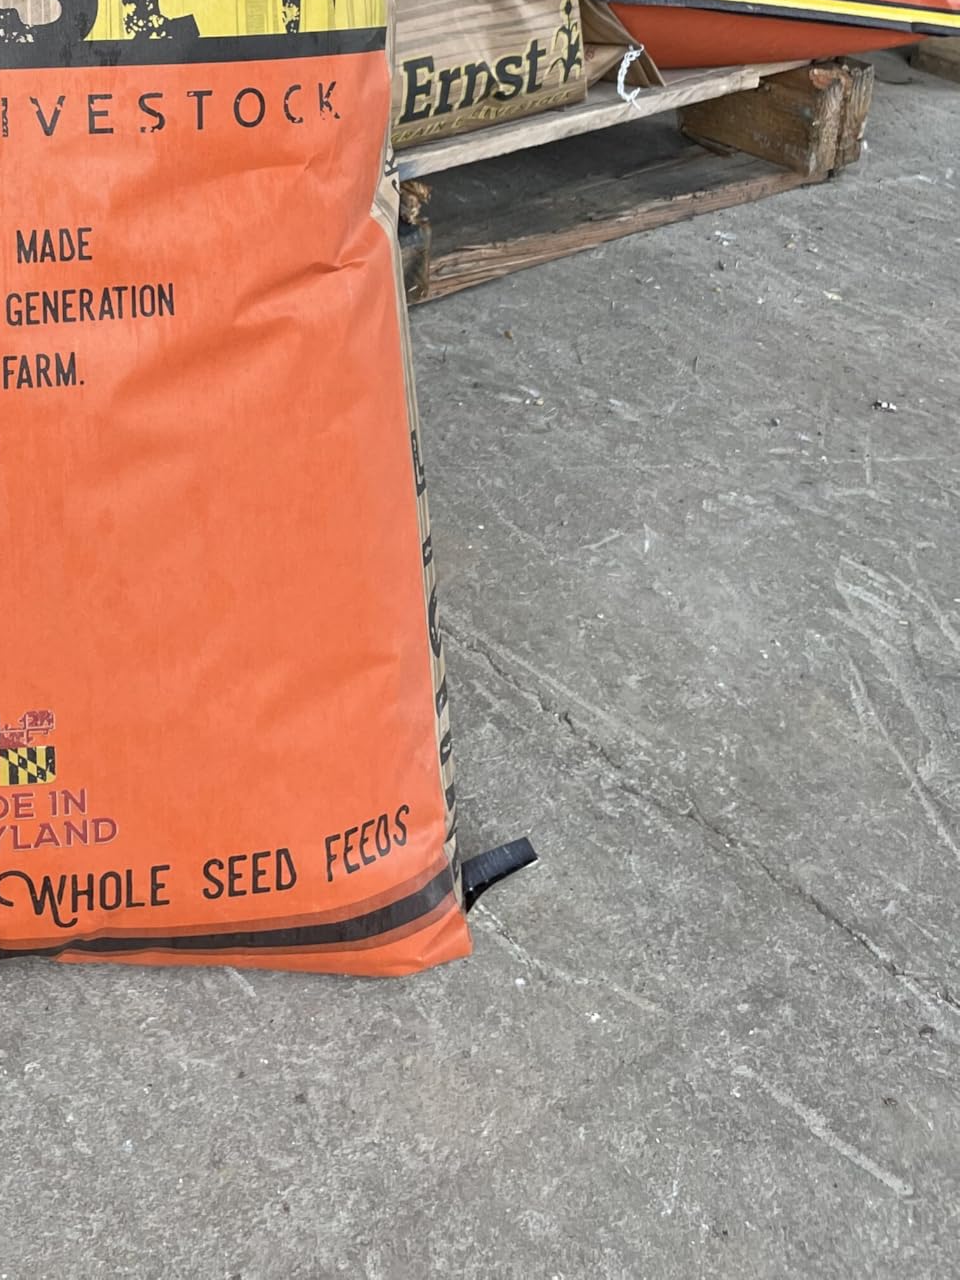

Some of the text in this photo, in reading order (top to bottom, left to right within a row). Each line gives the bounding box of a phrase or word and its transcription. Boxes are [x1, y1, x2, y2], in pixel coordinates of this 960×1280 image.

[393, 37, 547, 128] Ernst
[15, 227, 94, 265] MADE
[5, 284, 176, 327] GENERATION
[2, 353, 86, 391] FARM.
[48, 787, 88, 818] IN
[202, 847, 298, 901] SEED
[324, 804, 411, 883] FEEDS
